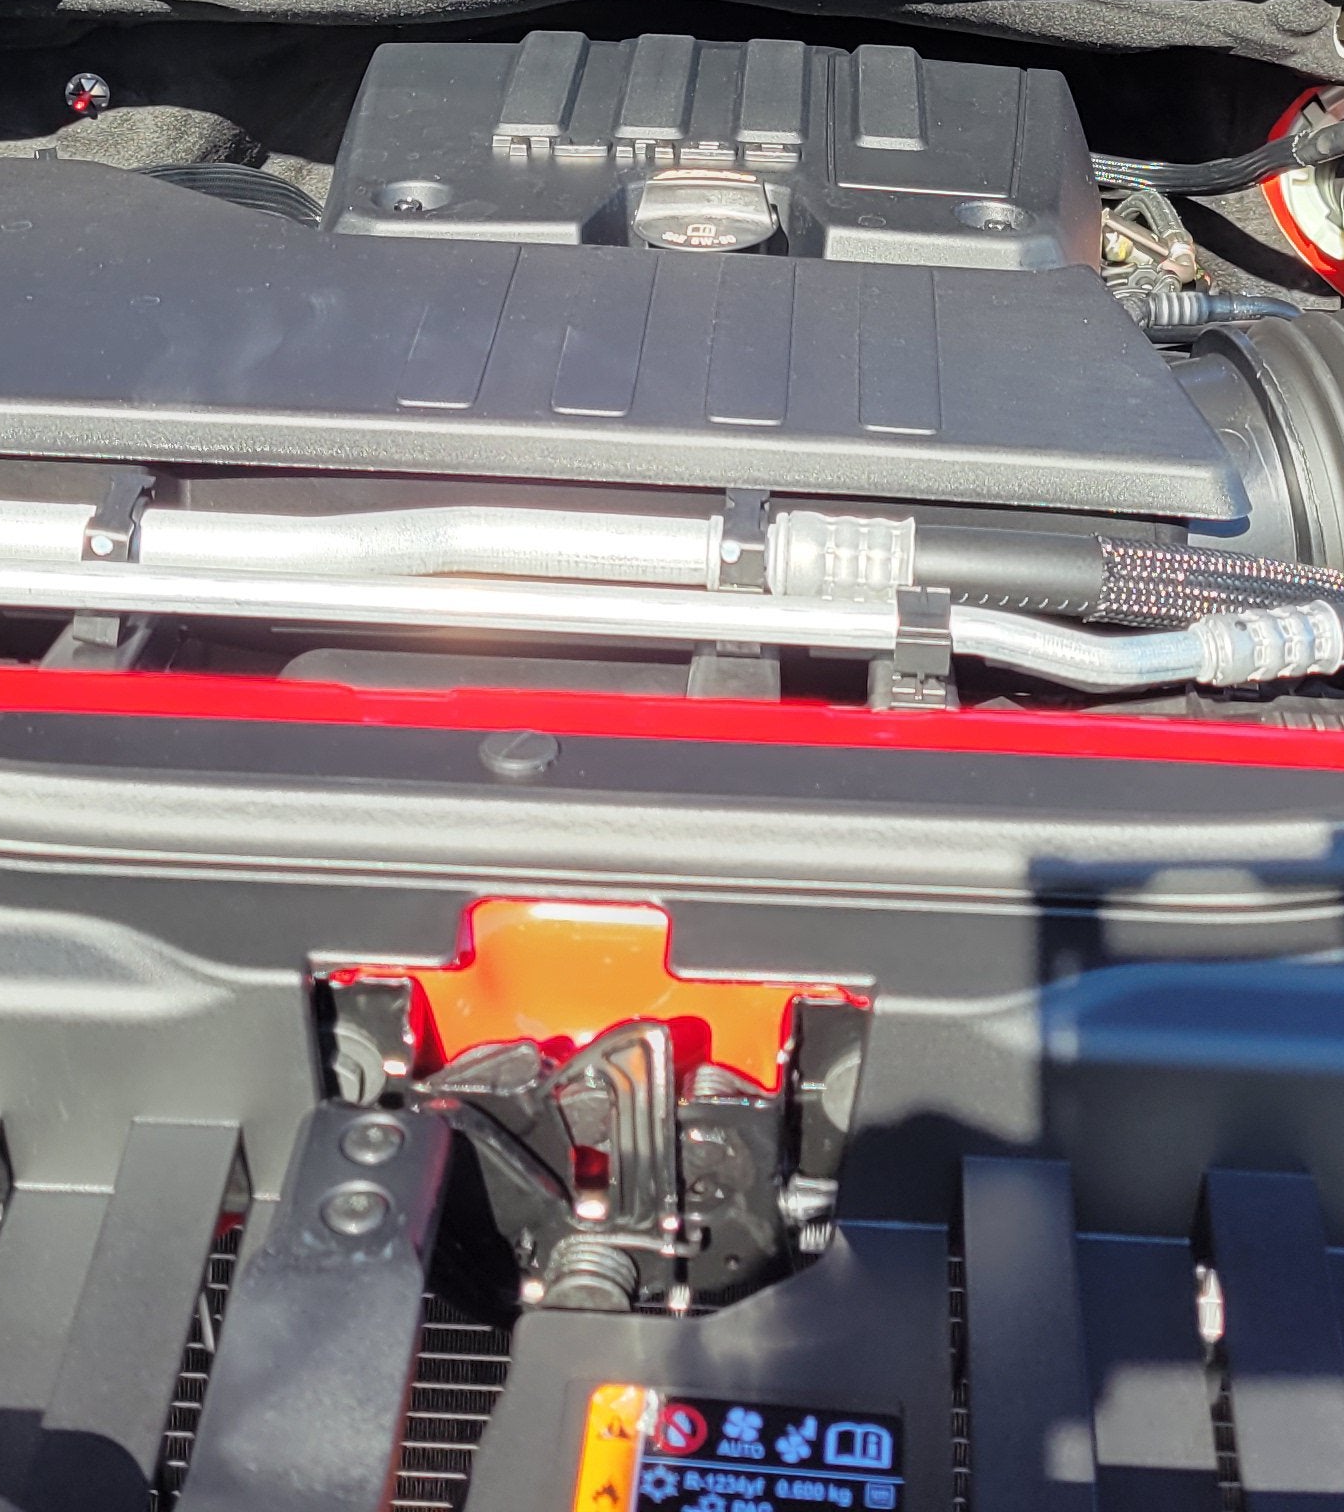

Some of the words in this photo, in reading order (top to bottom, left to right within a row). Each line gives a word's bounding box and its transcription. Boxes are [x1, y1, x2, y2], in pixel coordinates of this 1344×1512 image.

[716, 1439, 766, 1459] AUTO
[683, 1470, 766, 1499] R-1234yf
[828, 1483, 853, 1508] kg
